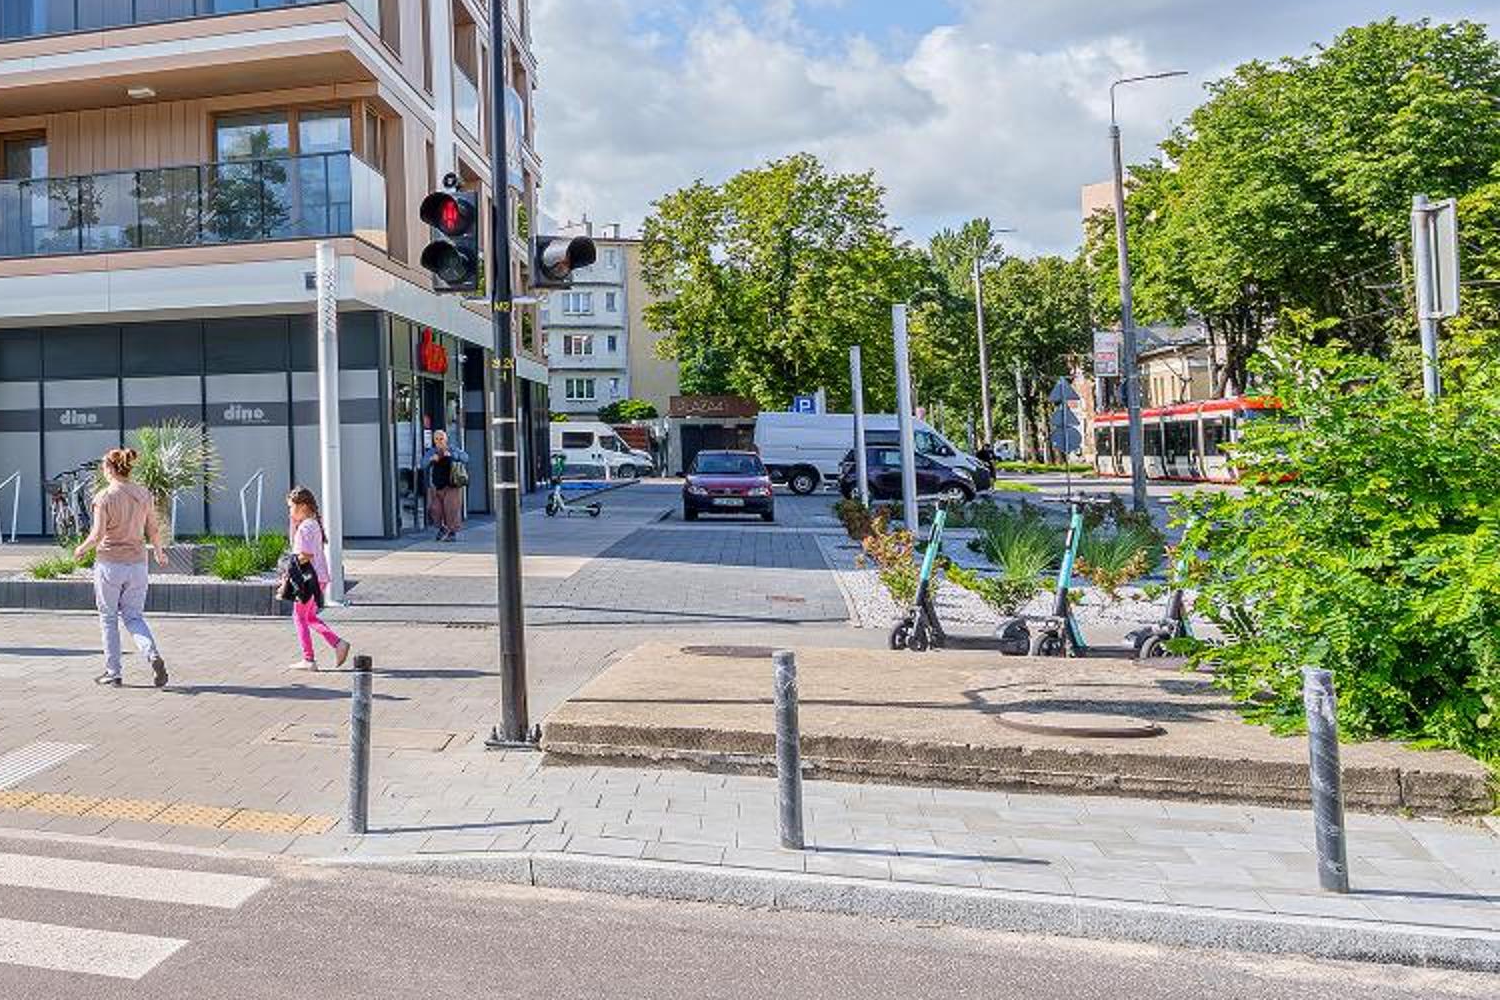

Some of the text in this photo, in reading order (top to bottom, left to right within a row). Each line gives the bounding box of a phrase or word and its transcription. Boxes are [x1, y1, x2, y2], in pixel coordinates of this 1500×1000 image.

[223, 403, 265, 421] dino
[799, 398, 811, 413] P
[59, 408, 98, 425] dino
